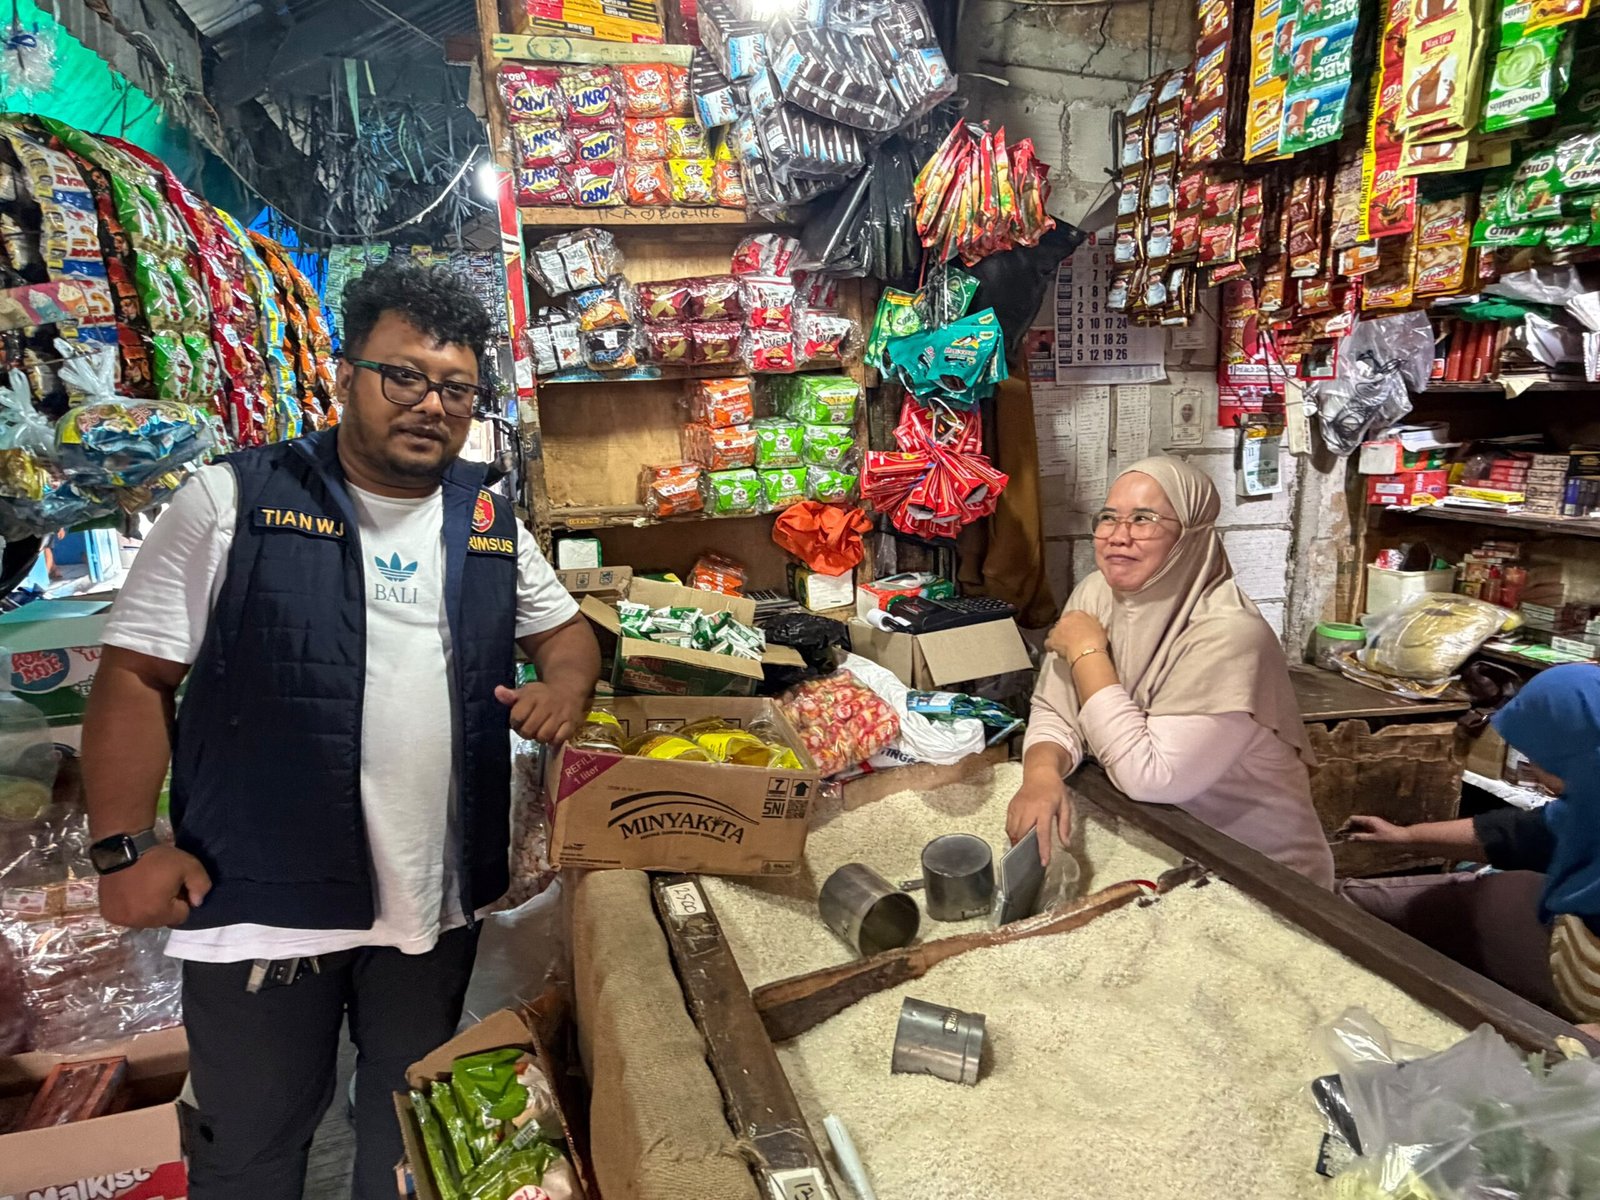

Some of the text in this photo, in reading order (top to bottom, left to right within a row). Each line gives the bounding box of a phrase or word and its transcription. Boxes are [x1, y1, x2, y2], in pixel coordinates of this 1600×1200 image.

[1253, 121, 1280, 142] NERGEN
[1306, 121, 1341, 142] ABC
[1490, 226, 1521, 236] MILO
[1093, 270, 1098, 281] 7
[1079, 286, 1098, 297] 1 8
[1077, 302, 1098, 313] 2 9
[1077, 317, 1127, 329] 3 10 17 24
[1077, 333, 1128, 345] 4 11 18 25
[1077, 349, 1127, 361] 5 12 19 26
[261, 508, 344, 537] TIAN WJ
[375, 583, 418, 605] BALI
[565, 753, 597, 777] REFILL
[573, 765, 600, 785] 1 liter
[775, 780, 784, 791] 7
[762, 801, 785, 816] SNI
[618, 812, 745, 845] MINYAKITA
